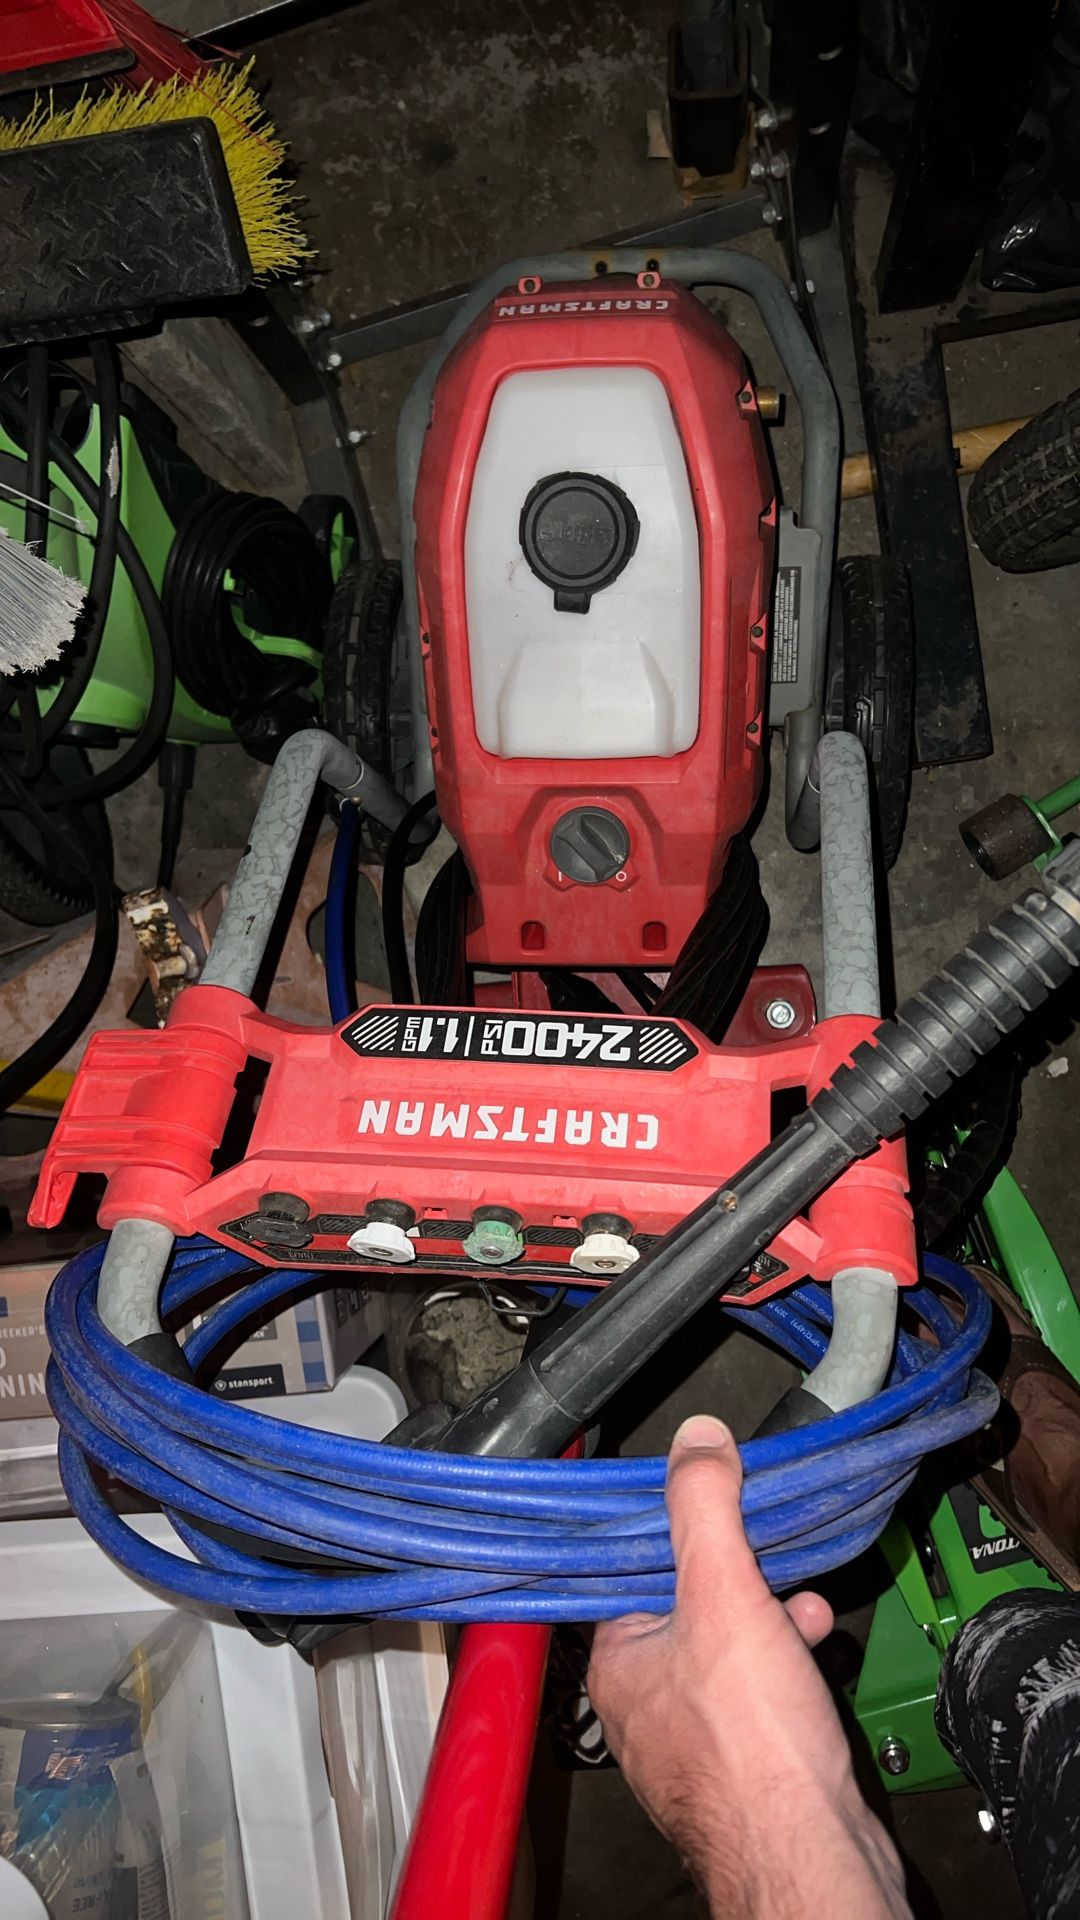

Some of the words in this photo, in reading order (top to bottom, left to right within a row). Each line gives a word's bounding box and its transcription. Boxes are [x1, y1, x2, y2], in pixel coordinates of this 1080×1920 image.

[498, 300, 669, 316] CRAFTSMAN
[417, 1017, 459, 1053] 1.1
[481, 1020, 503, 1055] PSI
[500, 1020, 634, 1062] 2400
[357, 1100, 660, 1150] CRAFTSMAN
[228, 1376, 273, 1389] stansport
